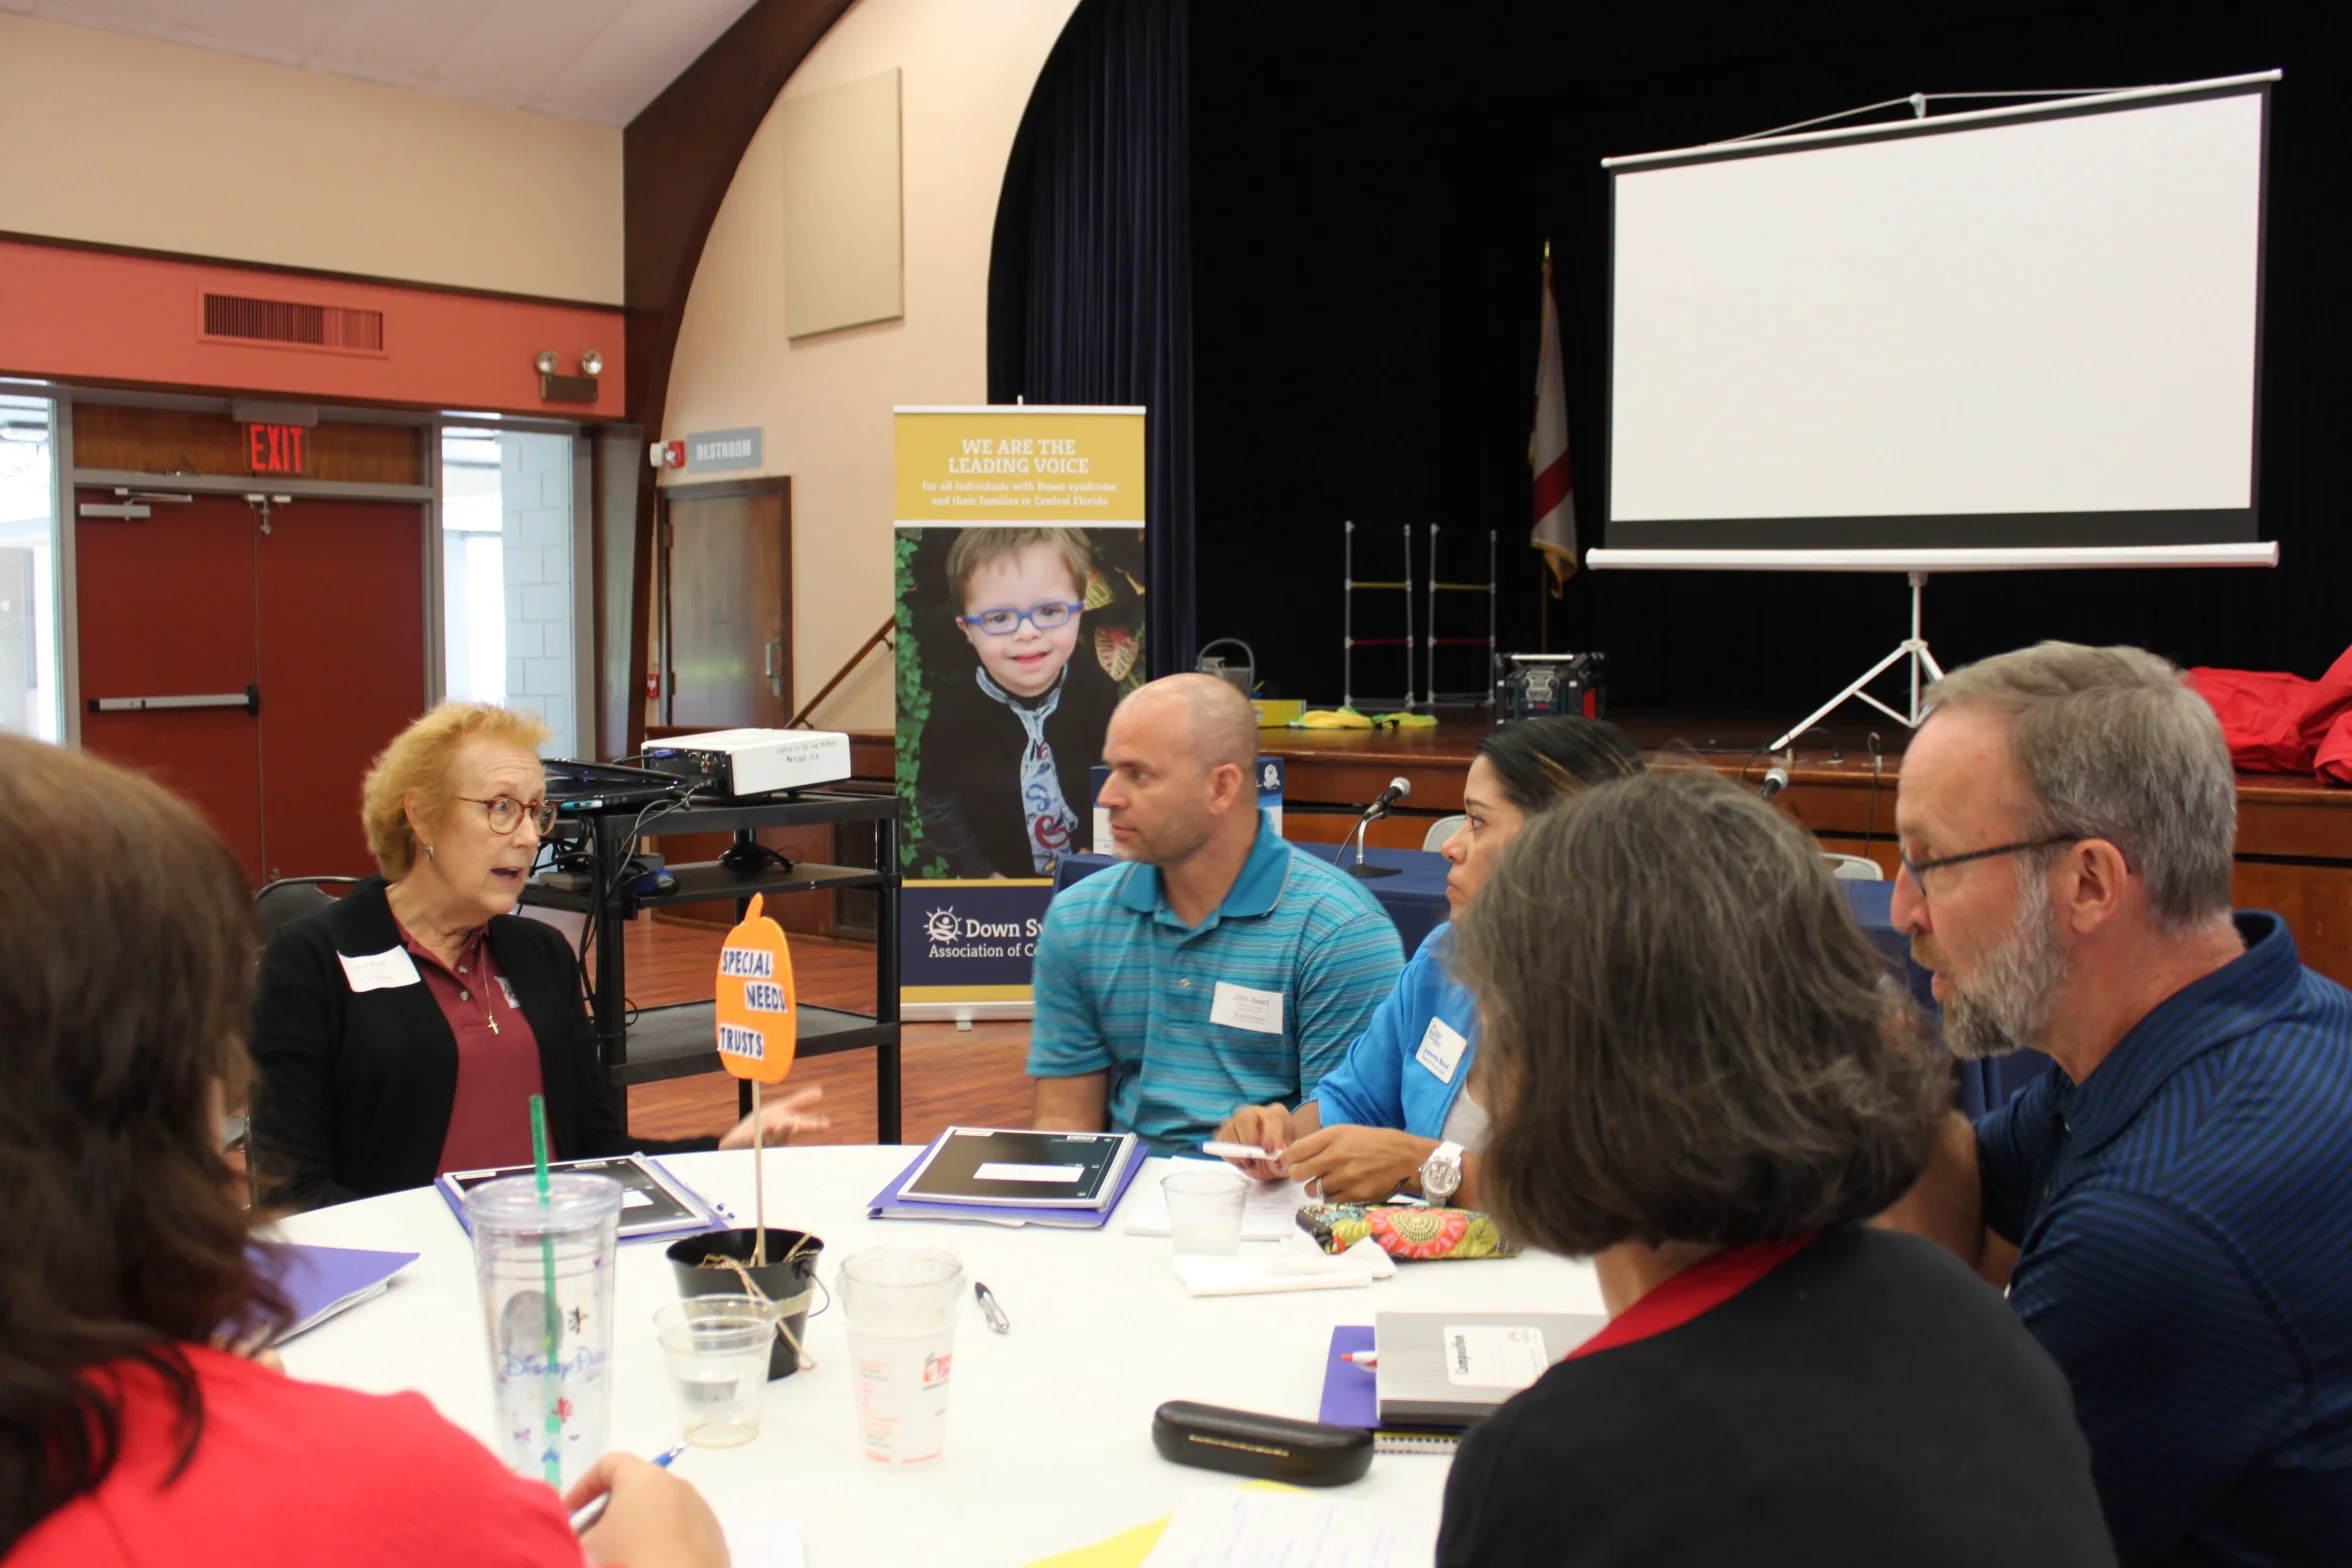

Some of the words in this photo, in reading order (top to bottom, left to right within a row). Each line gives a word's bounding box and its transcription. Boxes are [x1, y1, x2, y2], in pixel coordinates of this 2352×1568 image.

[250, 423, 304, 473] EXIT
[696, 440, 752, 460] RESTROOM
[961, 439, 993, 455] WE
[997, 439, 1034, 455] ARE
[1038, 439, 1076, 455] THE
[948, 457, 1030, 474] LEADING
[1033, 457, 1090, 474] VOICE
[922, 481, 938, 492] for
[940, 481, 953, 492] all
[955, 481, 1010, 492] individuals
[1012, 481, 1035, 492] with
[1037, 481, 1066, 492] Down
[1068, 482, 1118, 494] syndrome
[931, 496, 950, 506] and
[952, 495, 977, 506] their
[979, 495, 1019, 506] families
[1021, 495, 1032, 506] in
[1034, 495, 1071, 506] Central
[1073, 495, 1109, 506] Florida
[965, 919, 1021, 938] Down
[928, 944, 1004, 958] Association
[1007, 943, 1022, 957] of
[721, 950, 771, 977] SPECIAL
[720, 1026, 763, 1058] TRUSTS
